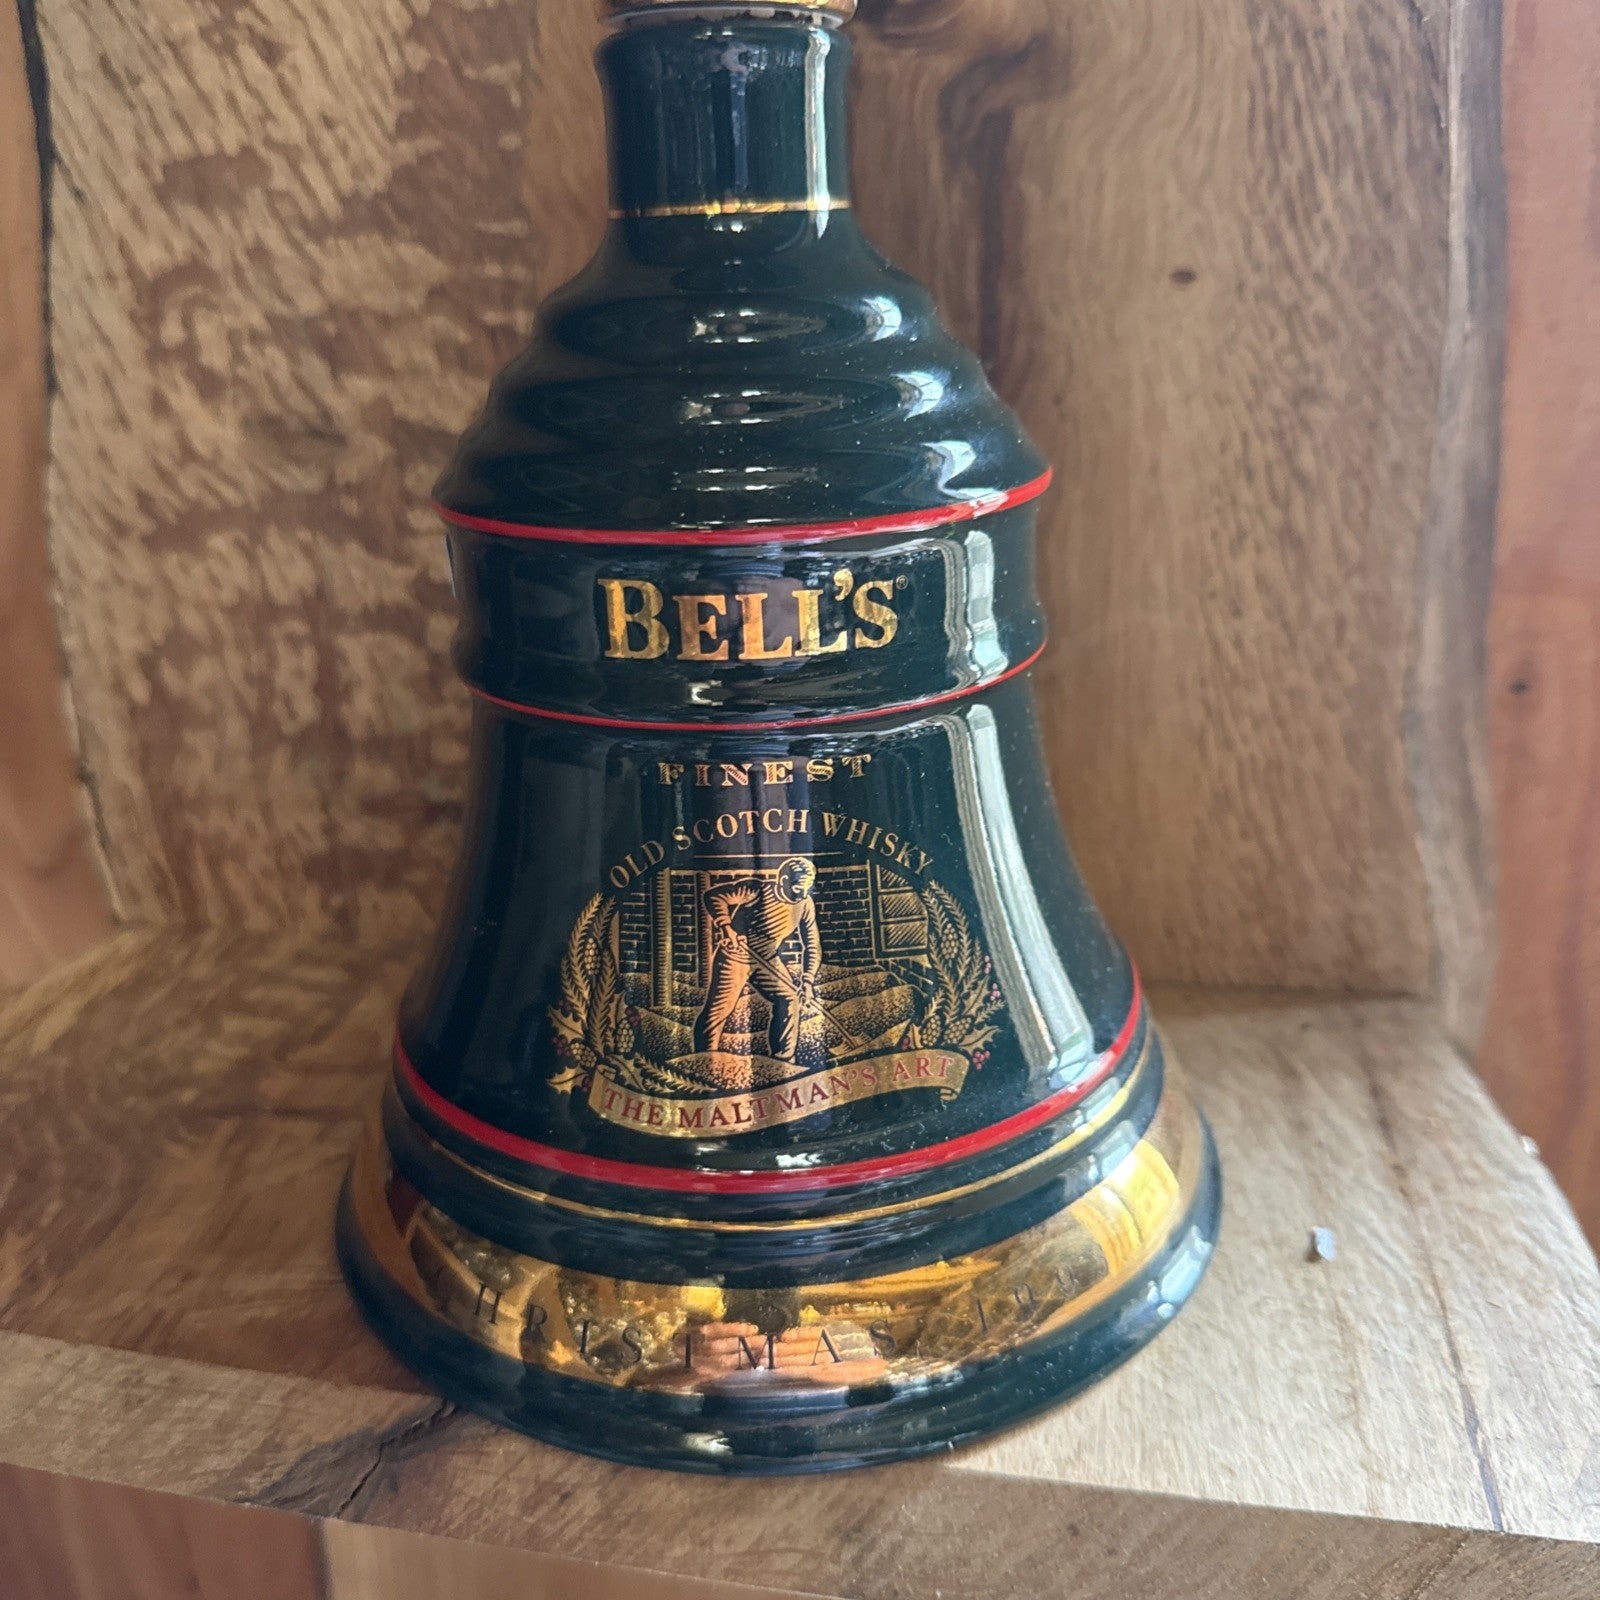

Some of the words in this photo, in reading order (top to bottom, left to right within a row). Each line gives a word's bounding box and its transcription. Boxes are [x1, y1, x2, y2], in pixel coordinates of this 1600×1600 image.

[657, 753, 872, 787] FINEST
[608, 840, 666, 890] OLD
[671, 808, 810, 852] SCOTCH
[821, 811, 935, 877] WHISKY
[604, 1087, 664, 1126] THE
[678, 1065, 878, 1129] MALTMAN'S
[892, 1053, 957, 1083] ART
[431, 1262, 899, 1371] HRISTMAS
